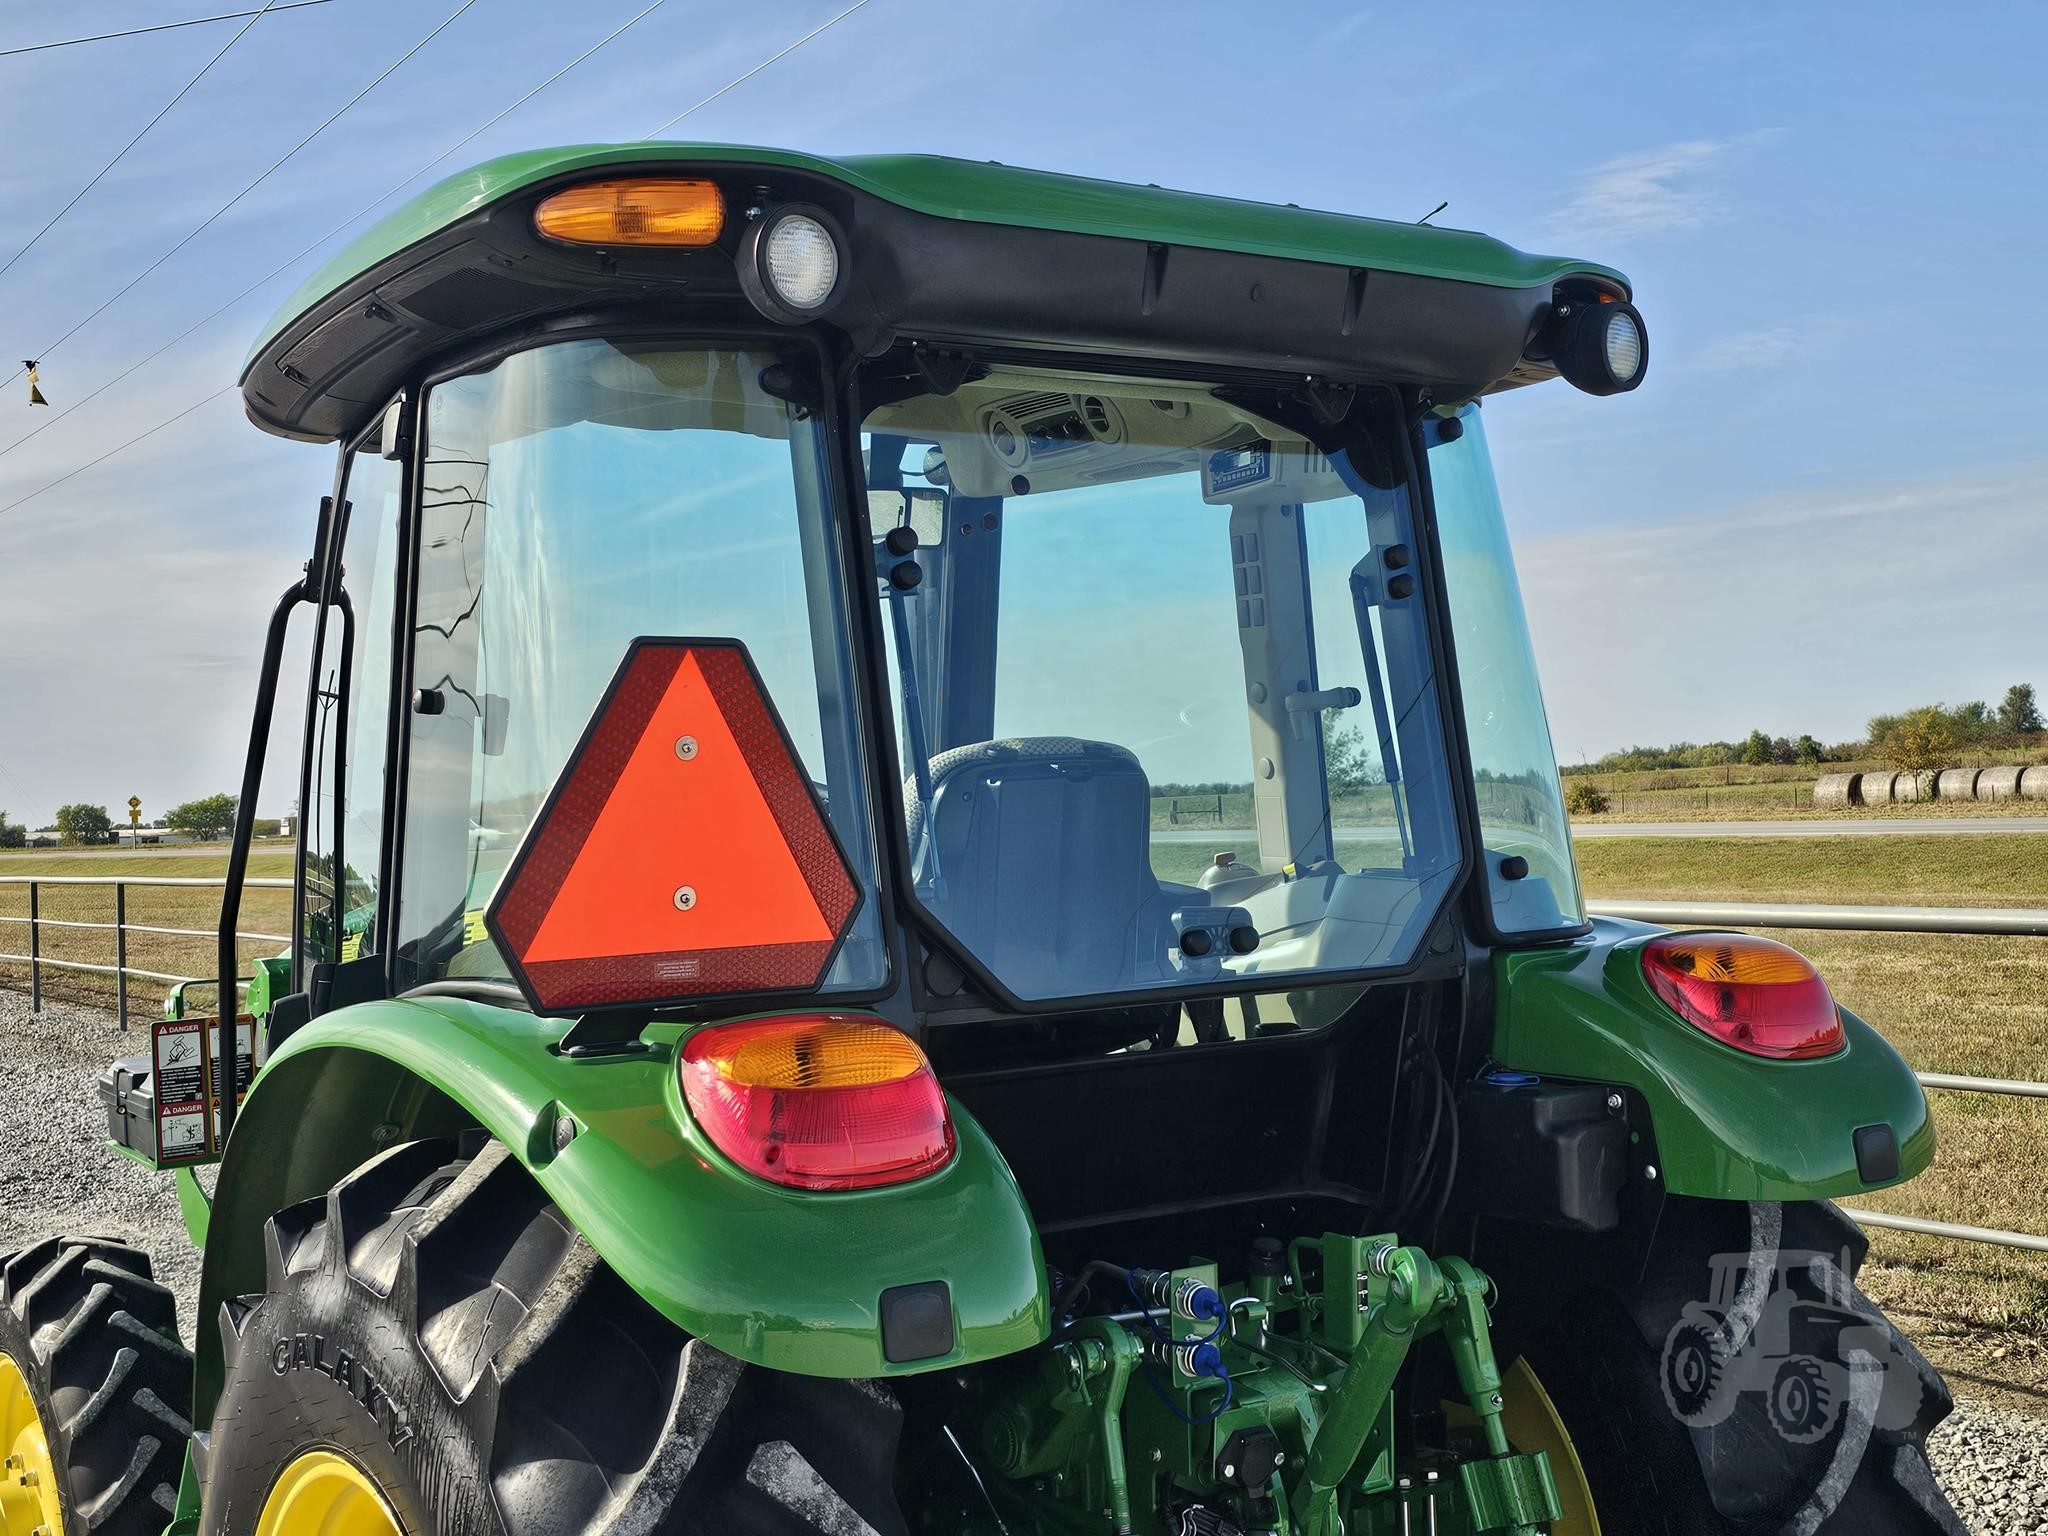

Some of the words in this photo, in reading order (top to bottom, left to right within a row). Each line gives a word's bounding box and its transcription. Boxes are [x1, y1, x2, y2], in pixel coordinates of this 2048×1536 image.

[168, 1024, 199, 1034] DANGER
[172, 1104, 203, 1114] DANGER
[272, 1332, 414, 1454] GALAXY
